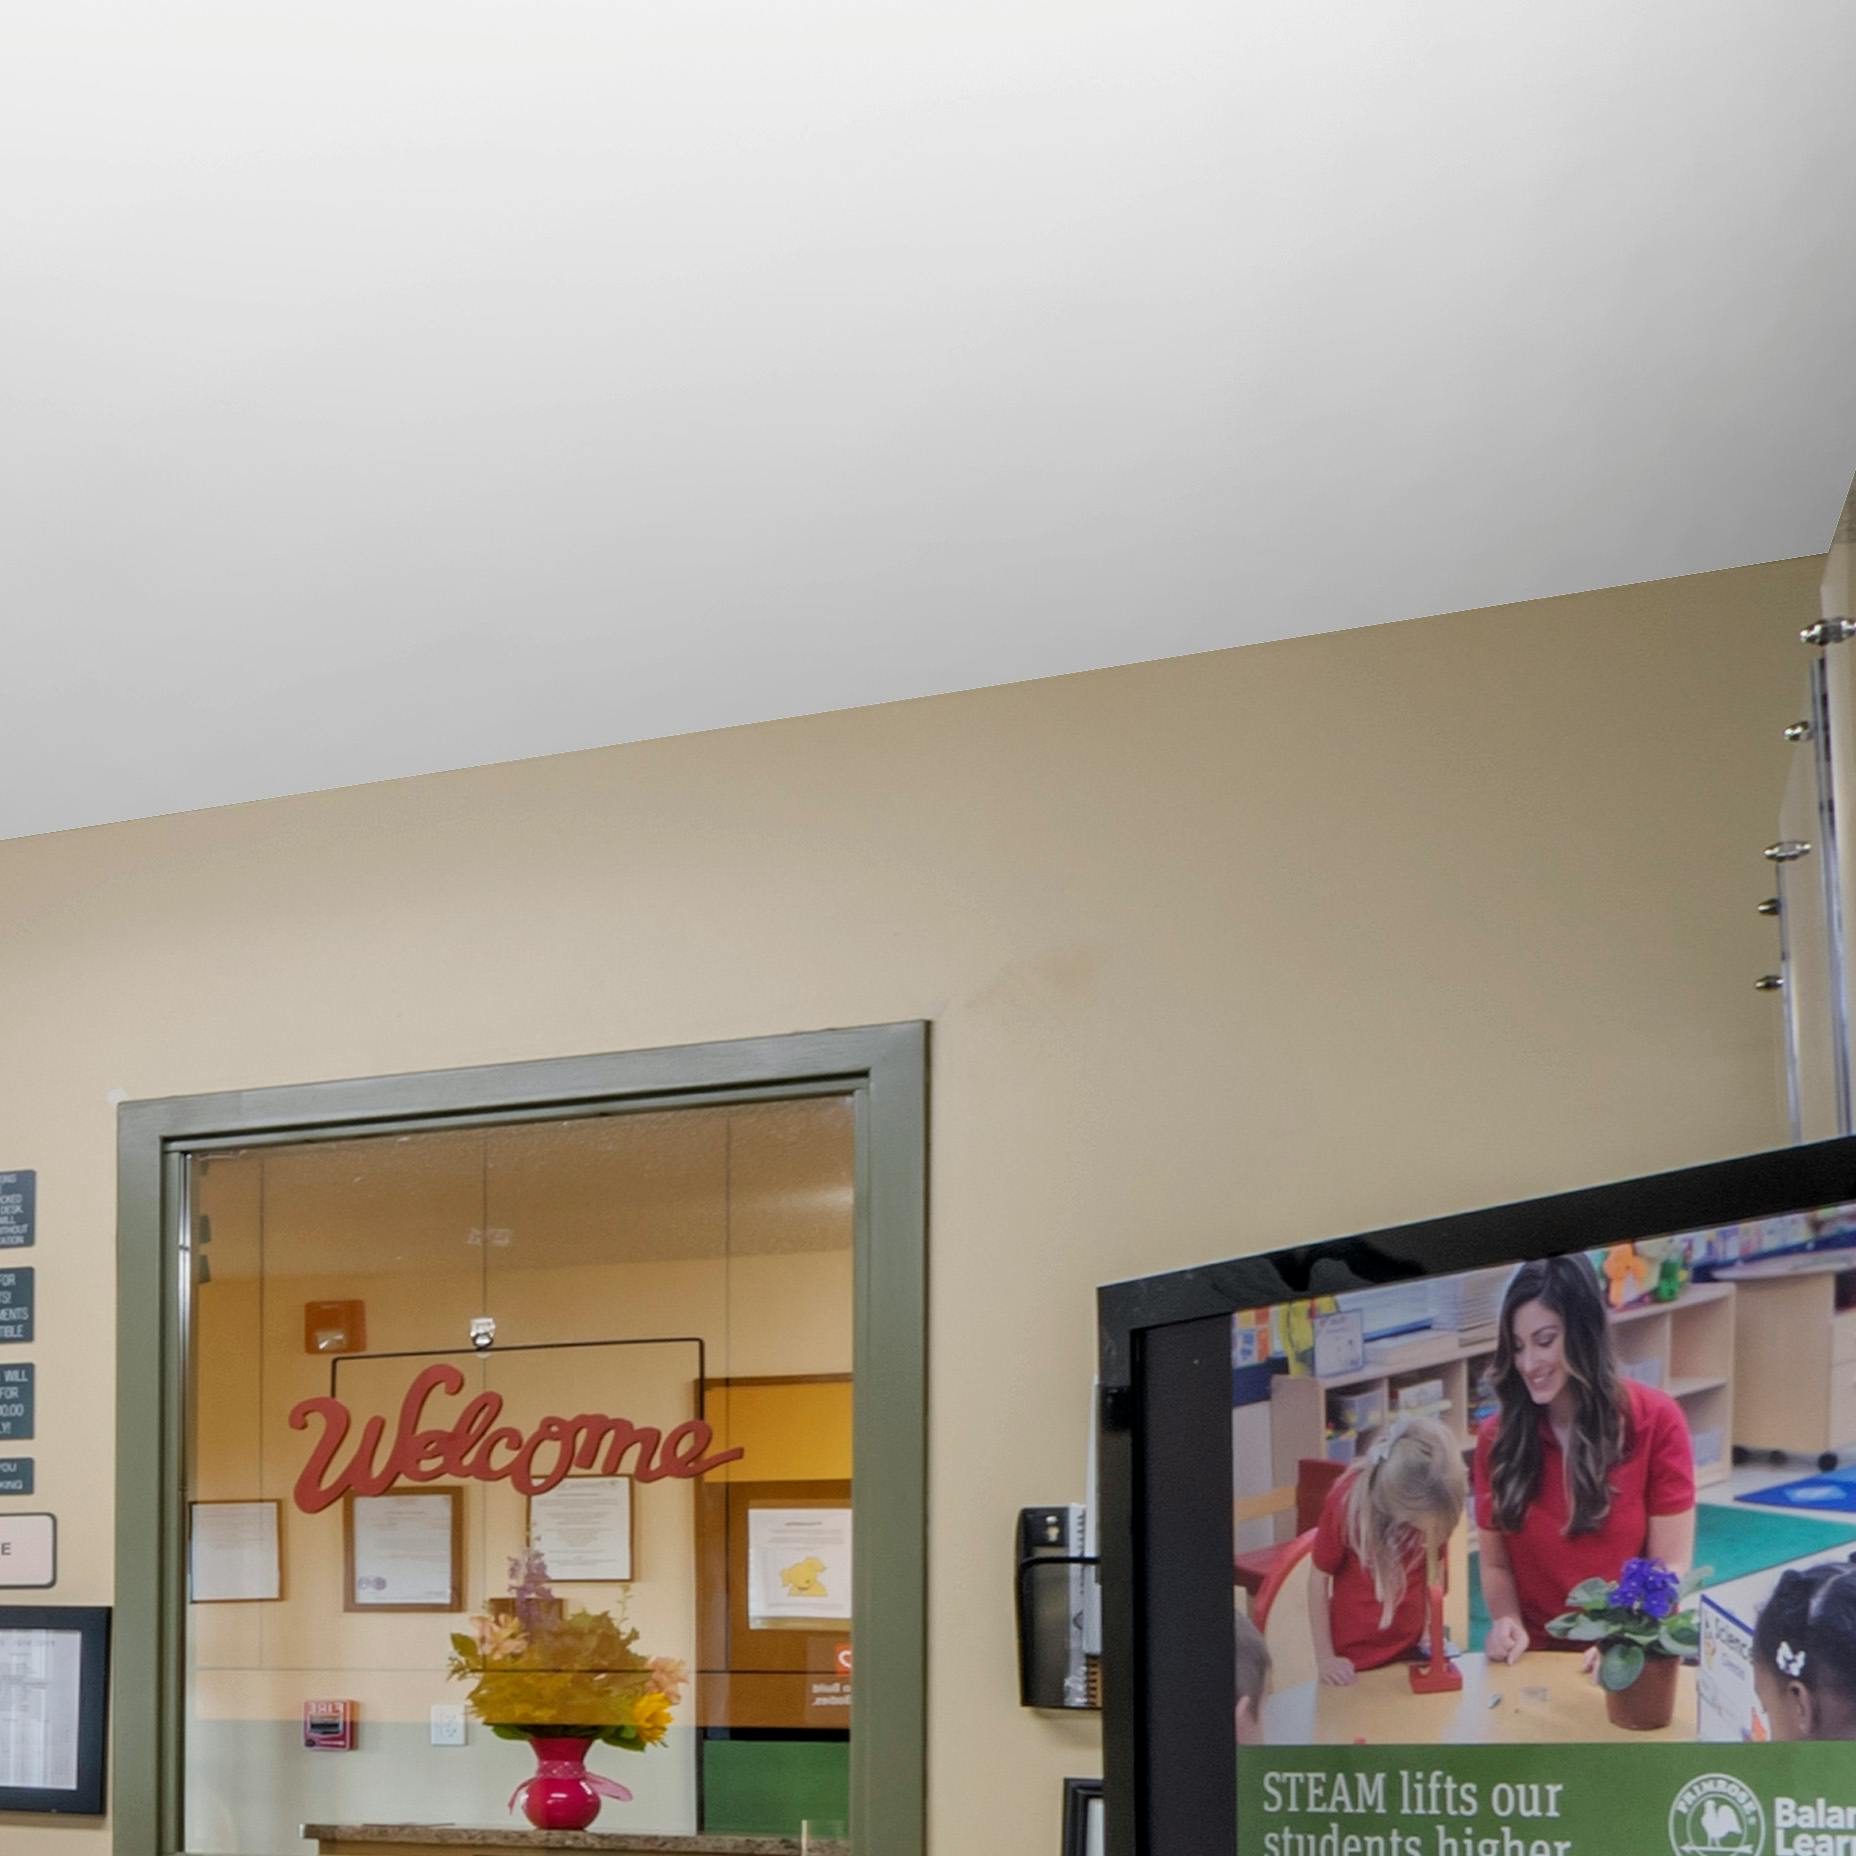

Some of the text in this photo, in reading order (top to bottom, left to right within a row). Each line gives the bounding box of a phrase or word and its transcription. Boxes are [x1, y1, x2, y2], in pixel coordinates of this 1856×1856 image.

[4, 1369, 28, 1382] WILL
[288, 1363, 744, 1514] Welcome
[1263, 1770, 1563, 1817] STEAM lifts our
[1677, 1779, 1757, 1814] PRIMROSE
